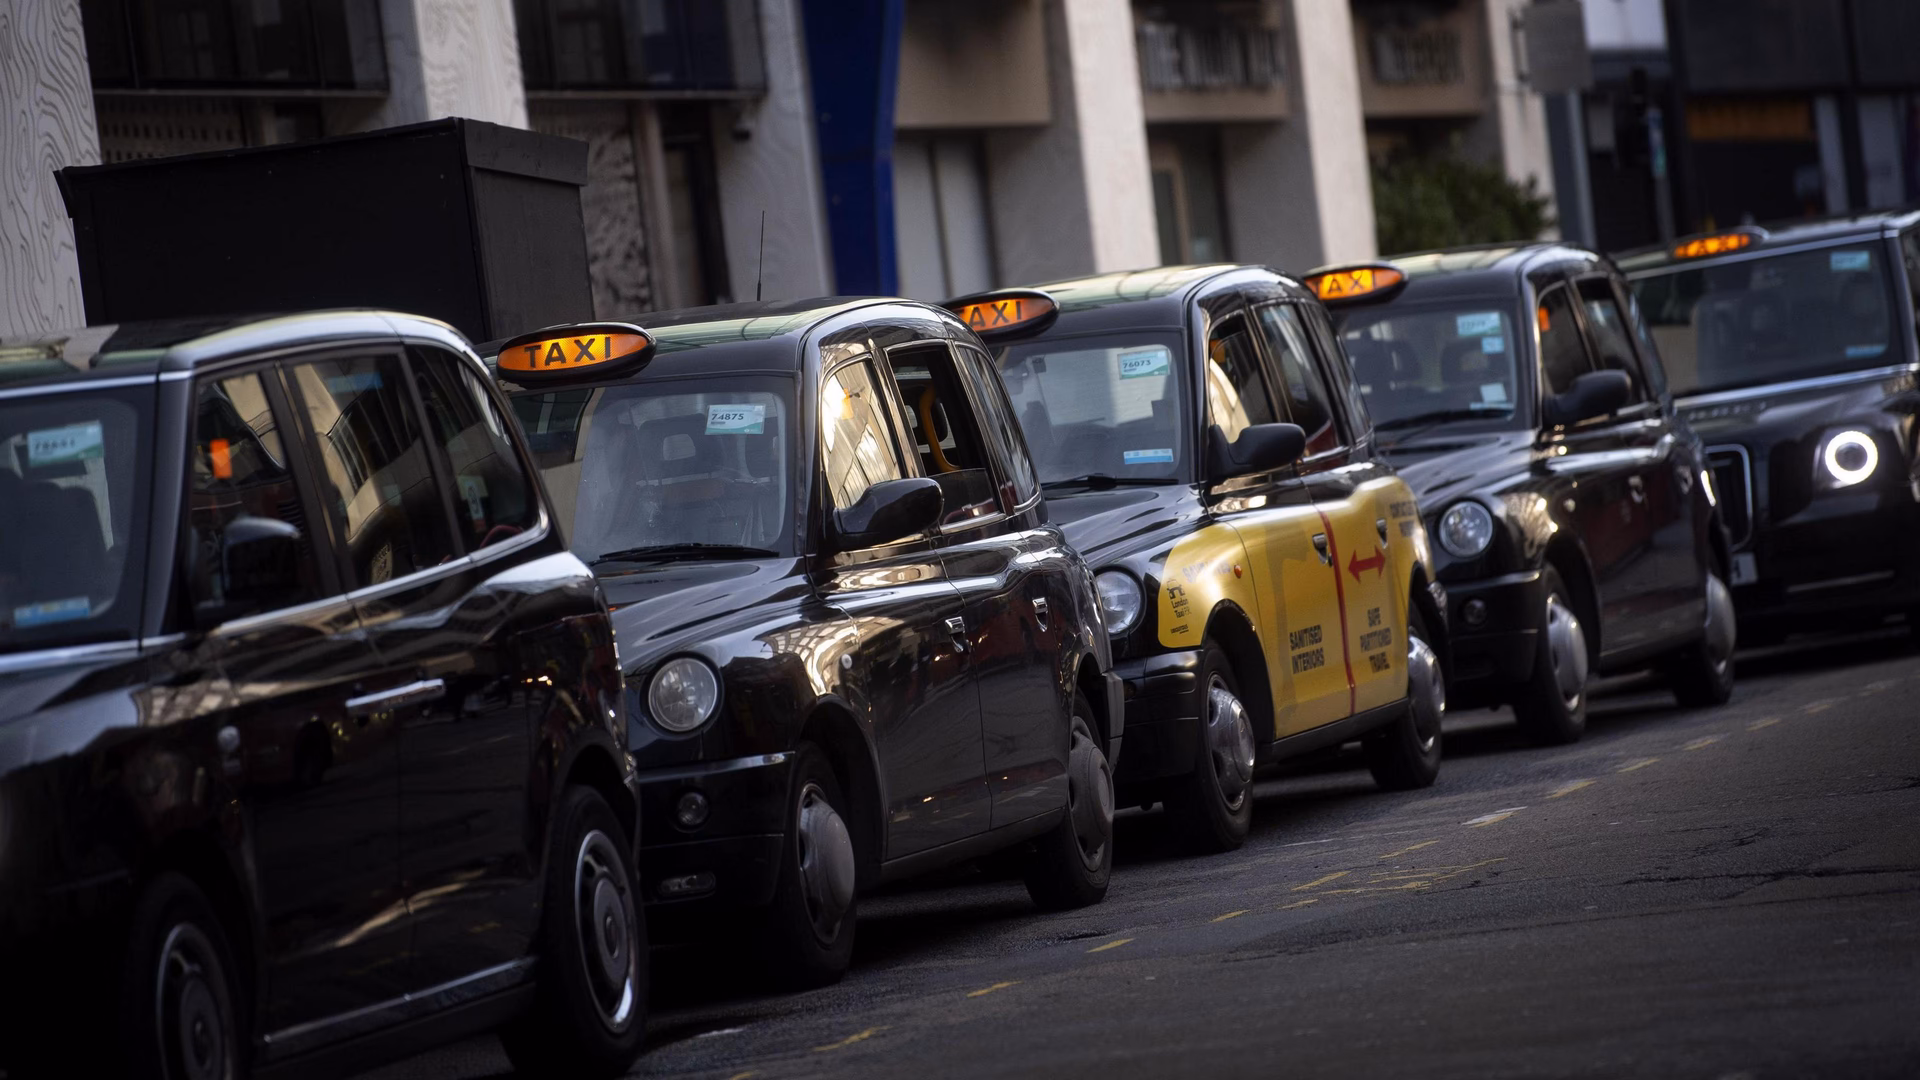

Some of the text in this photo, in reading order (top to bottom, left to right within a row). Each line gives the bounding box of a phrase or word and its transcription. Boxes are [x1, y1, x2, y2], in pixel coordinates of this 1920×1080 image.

[524, 337, 611, 368] TAXI
[711, 413, 745, 421] 74875
[1171, 598, 1189, 609] London
[1289, 624, 1323, 651] SANITISED
[1292, 647, 1325, 674] INTERIORS
